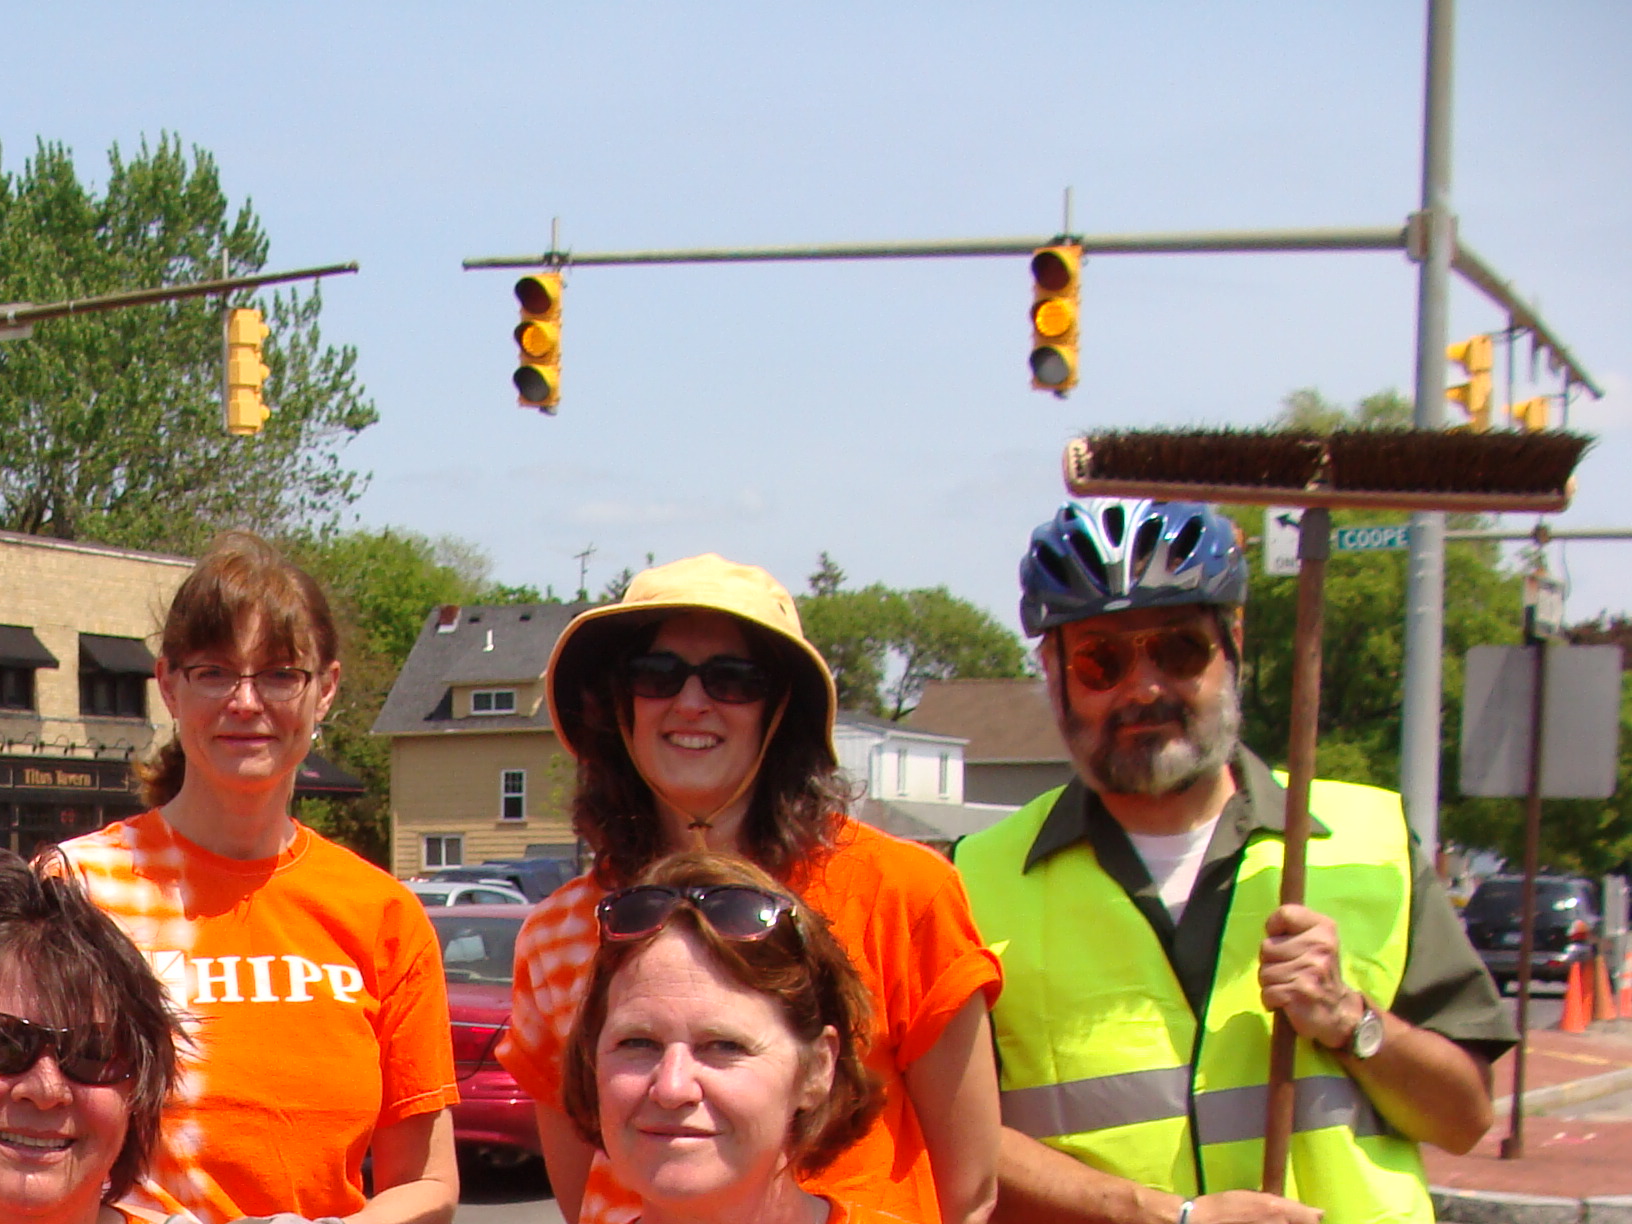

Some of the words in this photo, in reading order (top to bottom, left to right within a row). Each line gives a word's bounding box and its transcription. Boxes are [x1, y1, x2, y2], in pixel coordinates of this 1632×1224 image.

[1344, 527, 1409, 547] COOPE
[24, 768, 53, 785] Titus
[55, 770, 91, 787] Tavern
[190, 954, 364, 1004] HIPP
